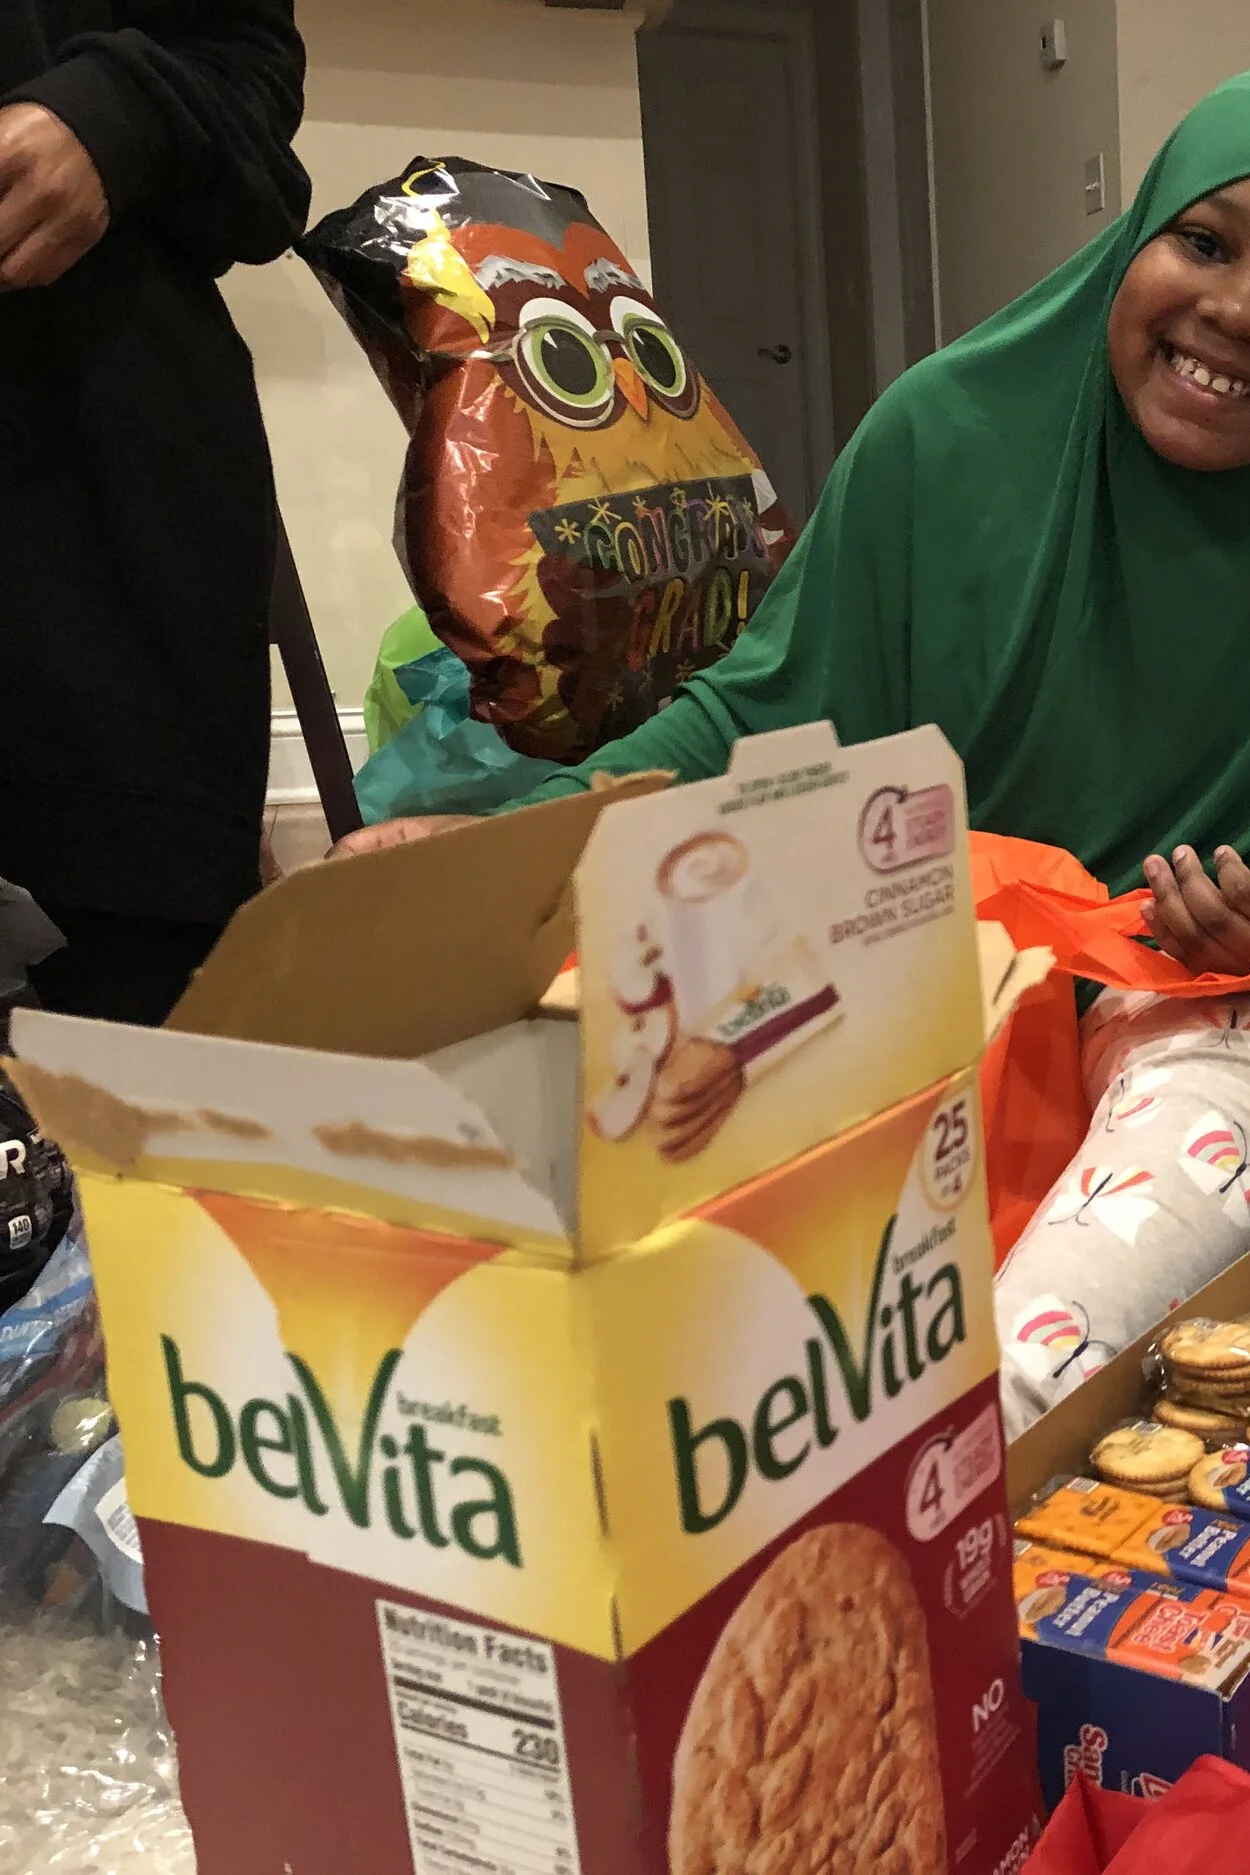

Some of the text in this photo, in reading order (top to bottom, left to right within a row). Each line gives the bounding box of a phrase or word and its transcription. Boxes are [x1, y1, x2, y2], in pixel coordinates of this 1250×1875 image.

[872, 805, 897, 850] 4
[933, 1099, 968, 1161] 25
[12, 1218, 30, 1236] 140
[666, 1214, 968, 1535] belVita
[160, 1333, 523, 1569] belVita
[918, 1460, 946, 1516] 4
[972, 1678, 1005, 1733] NO
